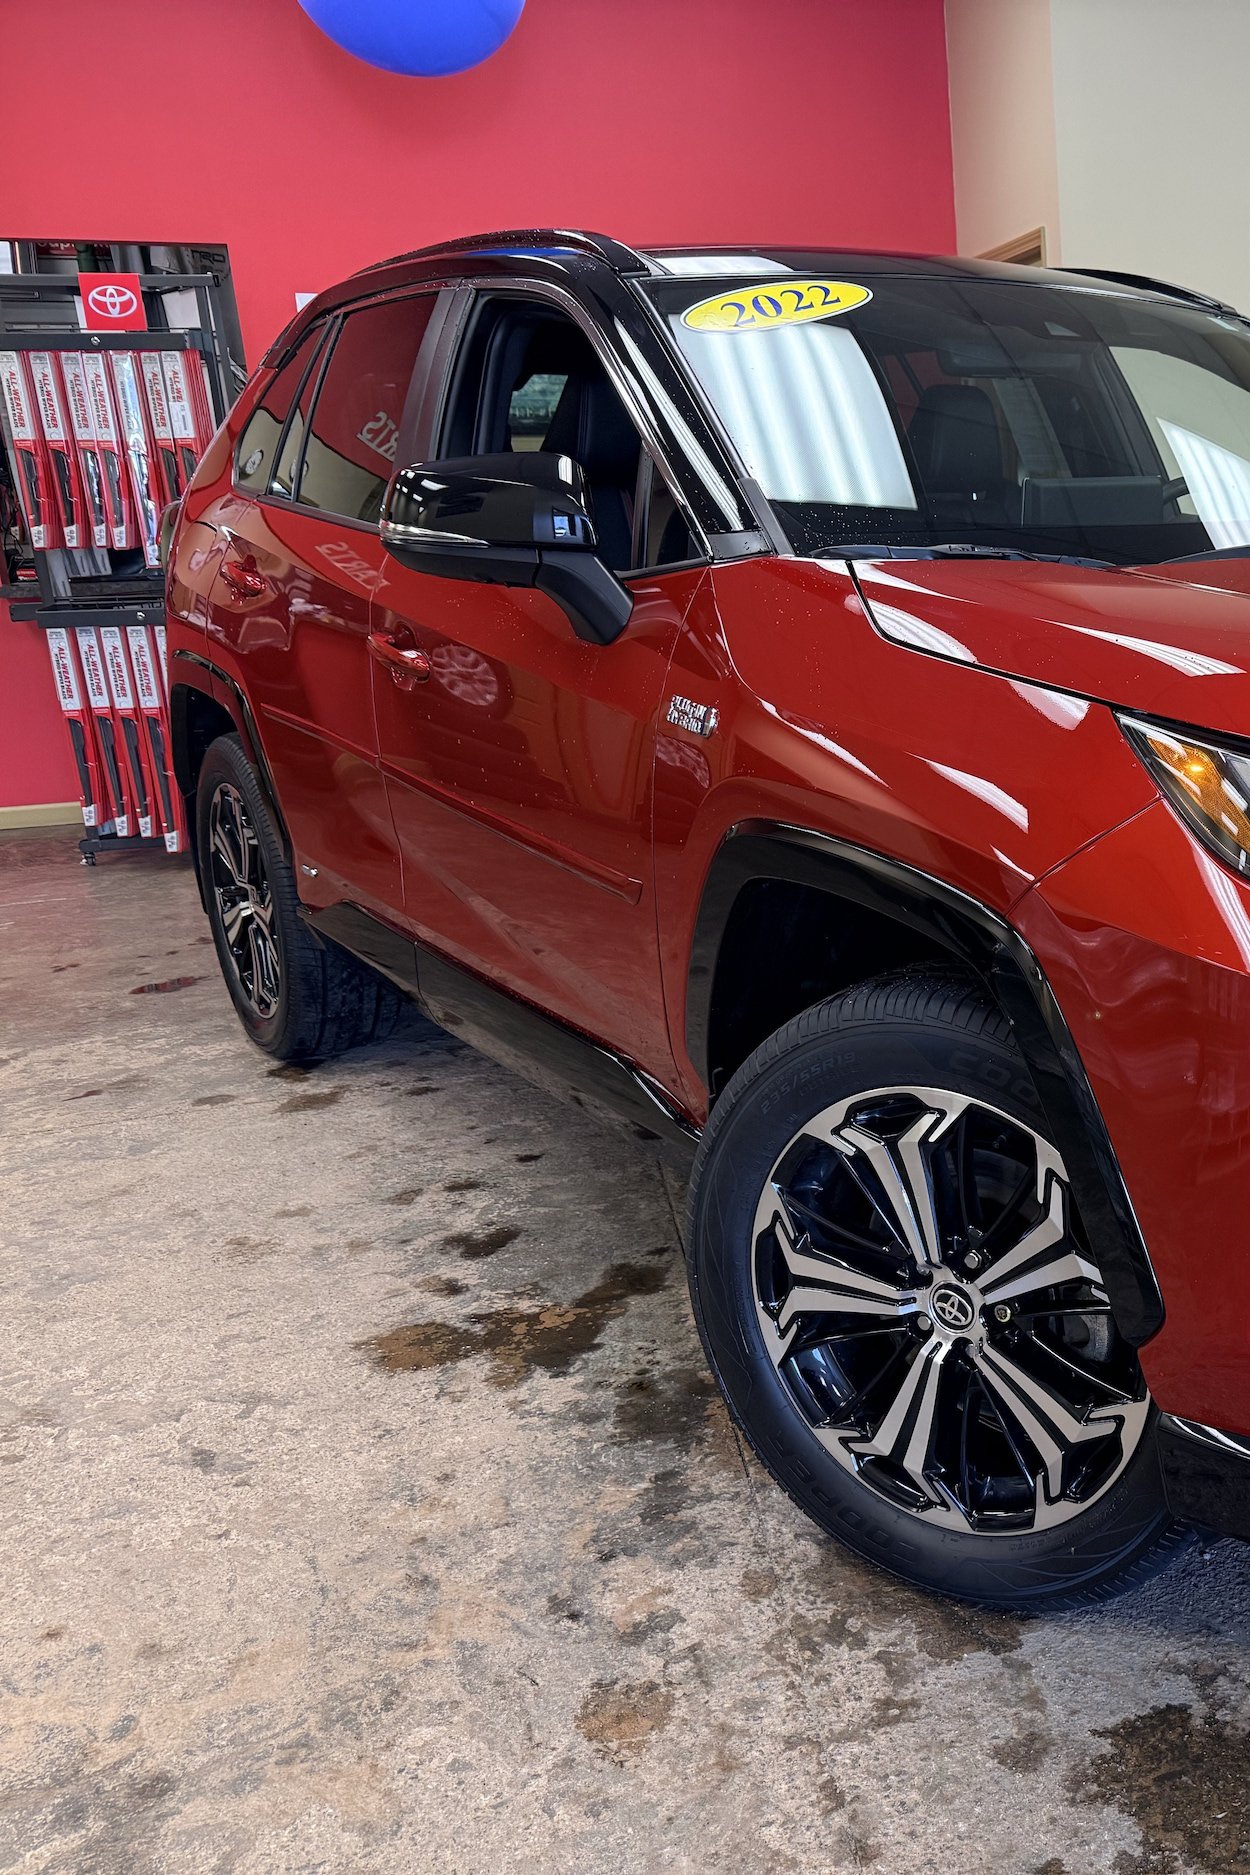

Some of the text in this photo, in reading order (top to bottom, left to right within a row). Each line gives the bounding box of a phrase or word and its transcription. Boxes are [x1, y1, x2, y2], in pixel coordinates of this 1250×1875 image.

[720, 284, 841, 328] 2022
[9, 370, 26, 428] ALL-WEATHER
[41, 372, 59, 429] ALL-WEATHER
[72, 372, 89, 429] ALL-WEATHER
[94, 373, 110, 429] ALL-WEATHER
[151, 371, 166, 428] ALL-WEATHER
[57, 646, 74, 699] ALL-WEATHER
[87, 644, 103, 696] ALL-WEATHER
[111, 645, 128, 698] ALL-WEATHER
[137, 645, 152, 697] ALL-WEATHER
